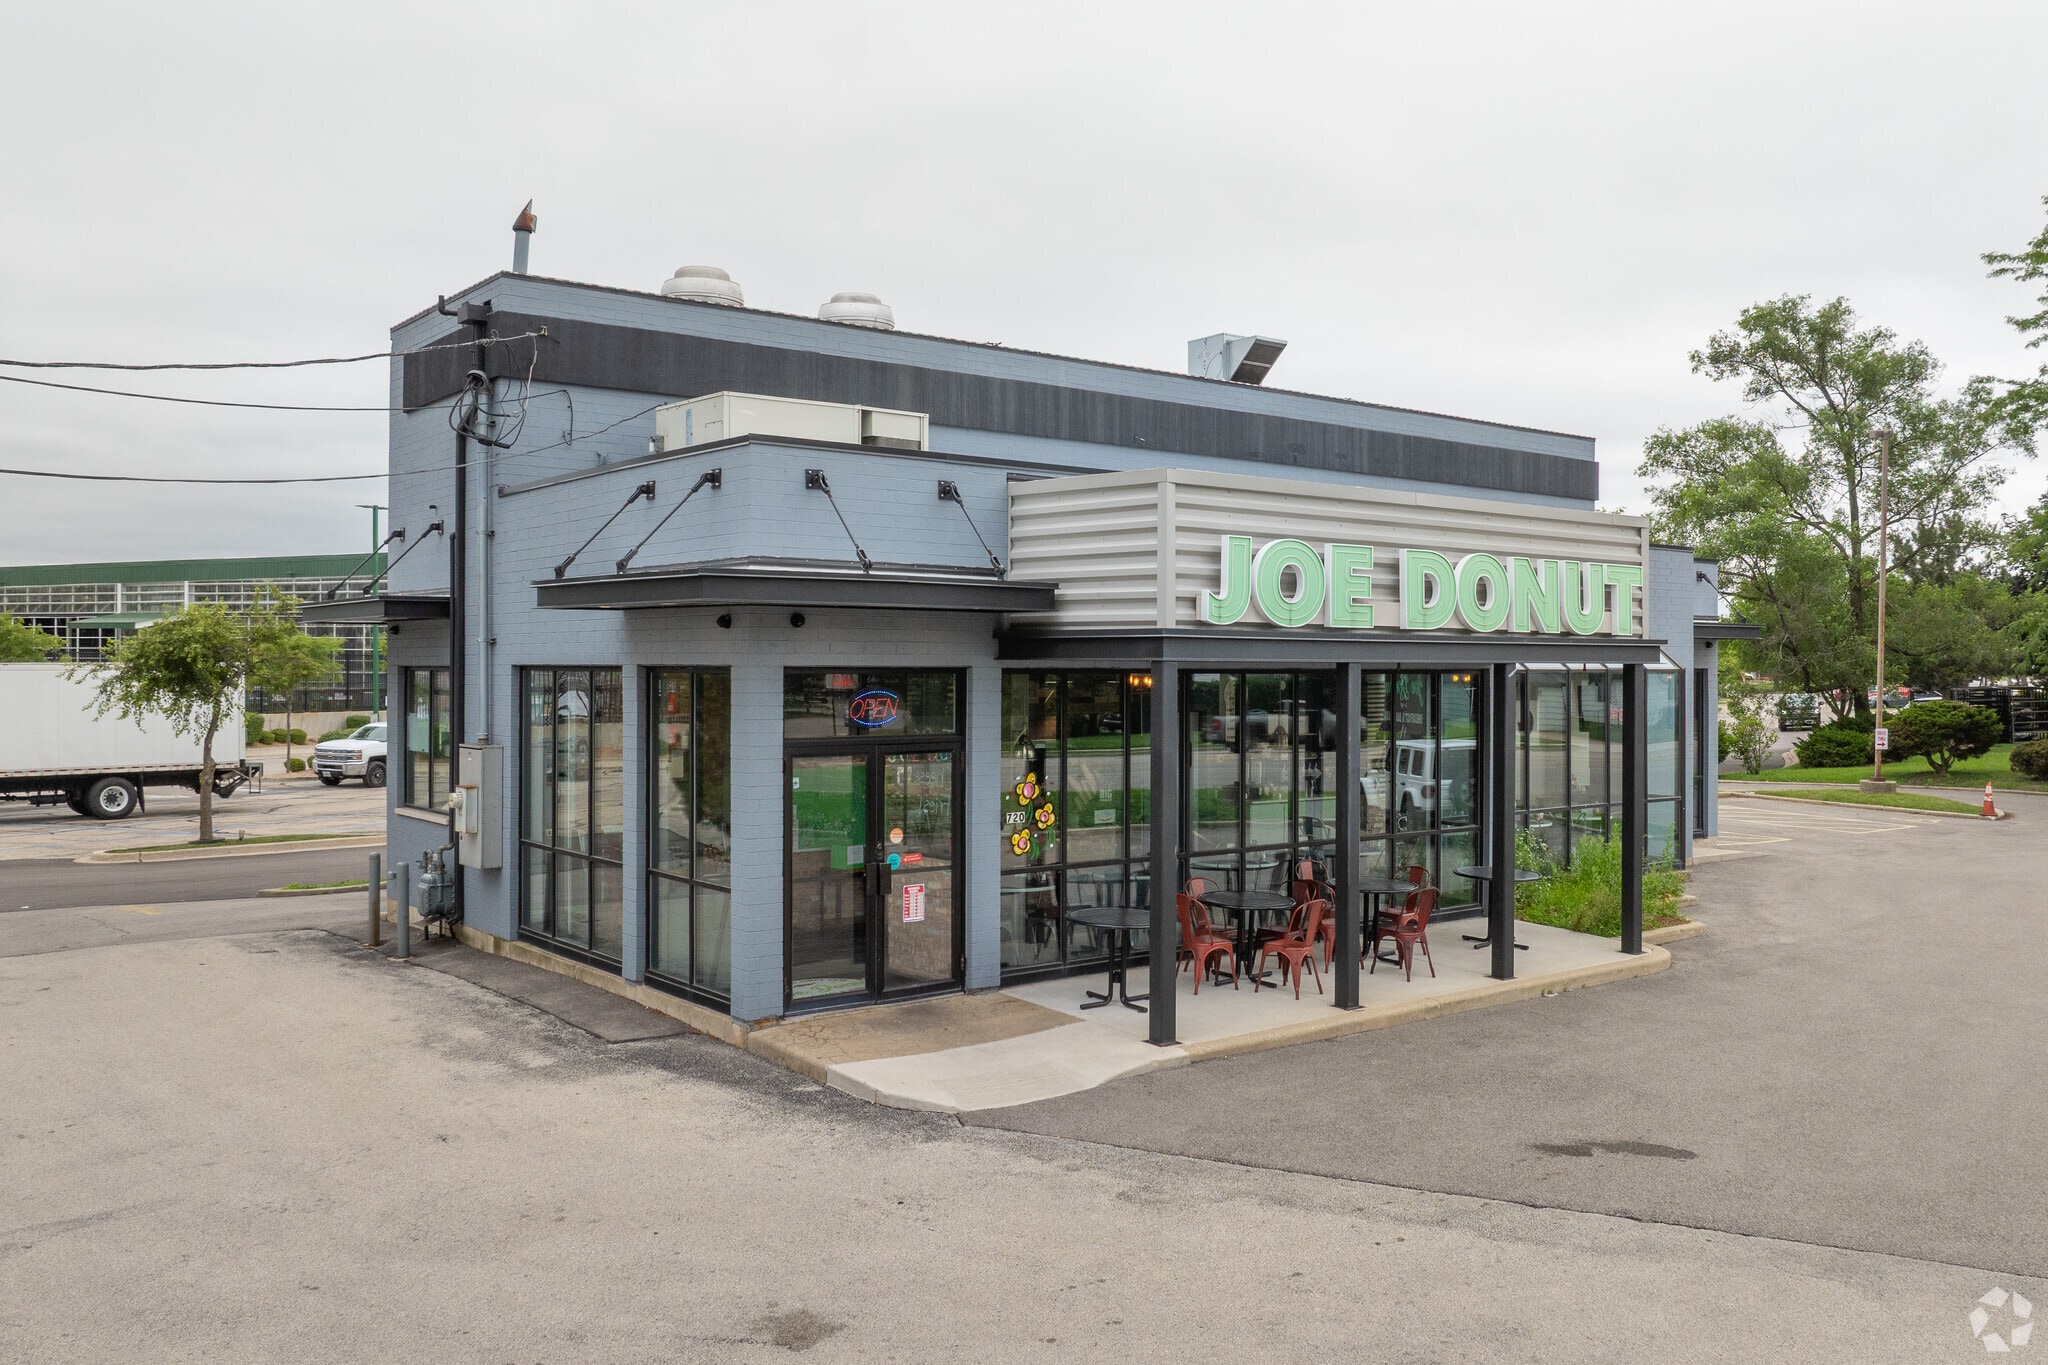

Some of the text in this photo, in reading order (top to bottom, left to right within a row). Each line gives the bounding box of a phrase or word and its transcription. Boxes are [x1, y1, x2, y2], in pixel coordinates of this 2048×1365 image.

[1201, 534, 1643, 635] JOE DONUT
[850, 698, 899, 718] OPEN
[1007, 812, 1025, 823] 720
